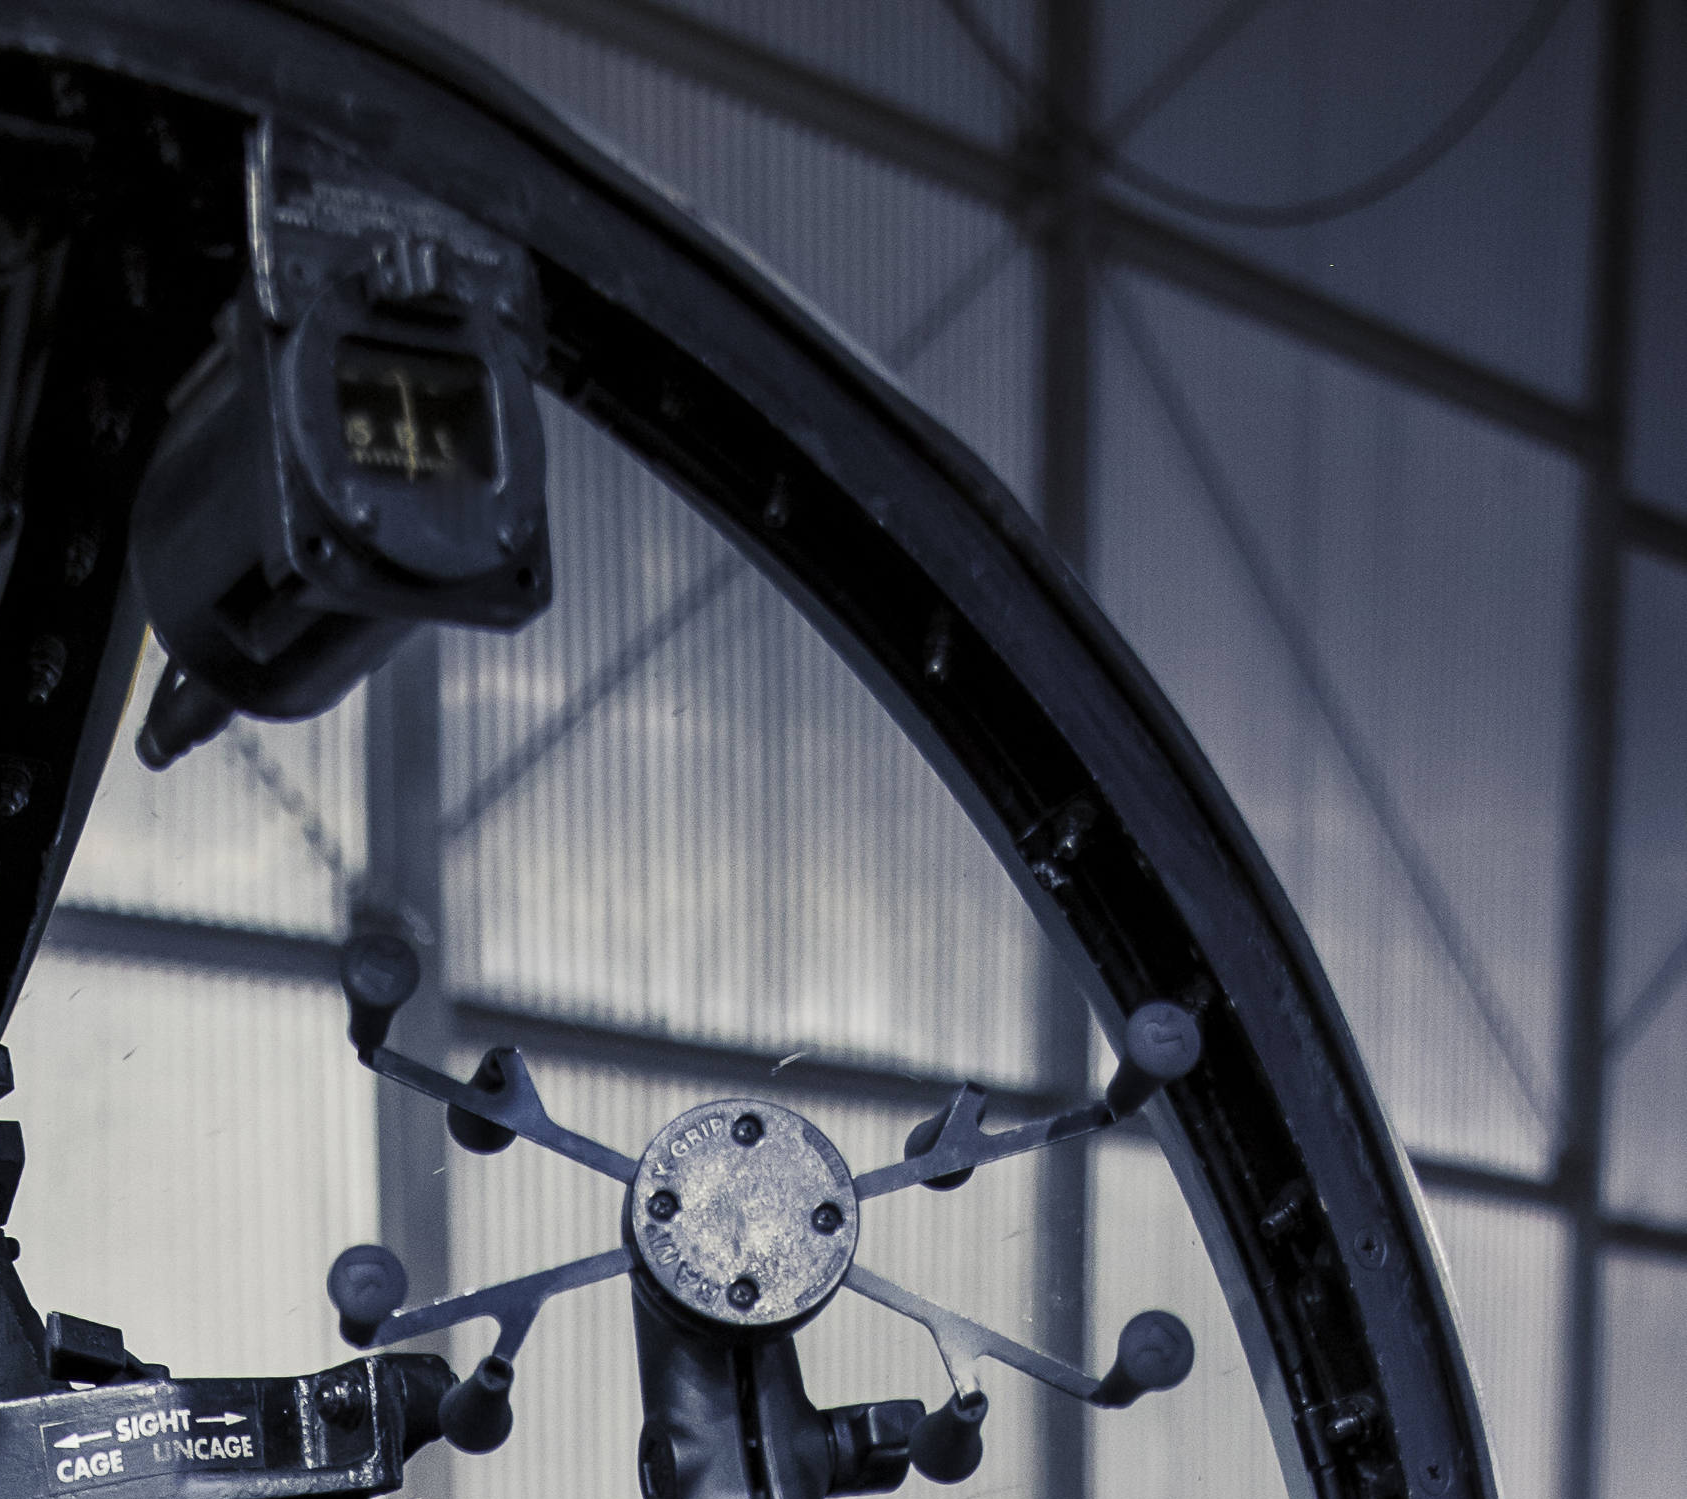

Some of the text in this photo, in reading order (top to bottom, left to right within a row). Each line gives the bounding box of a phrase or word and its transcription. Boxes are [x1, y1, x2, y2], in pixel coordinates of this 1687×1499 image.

[115, 1409, 190, 1442] SIGHT
[56, 1435, 253, 1482] CAGE UNCAGE
